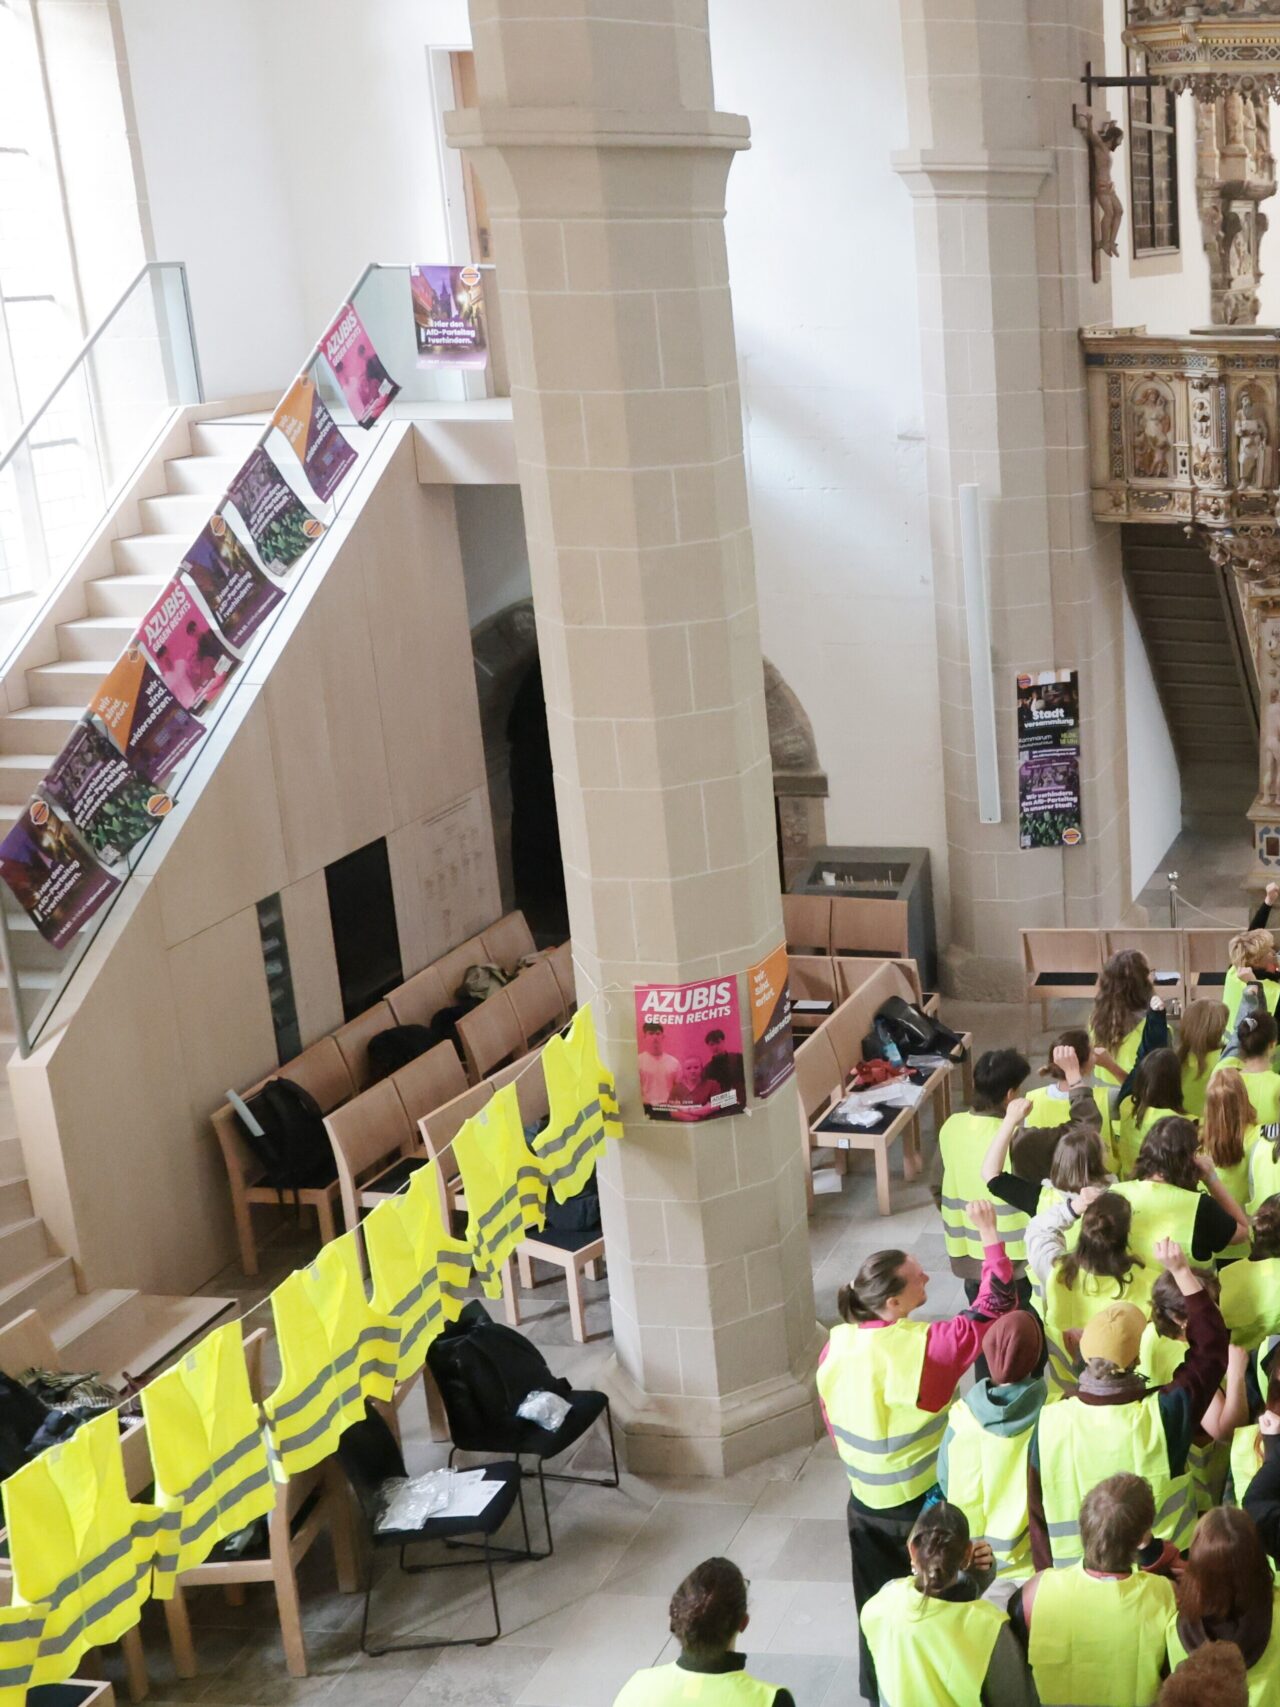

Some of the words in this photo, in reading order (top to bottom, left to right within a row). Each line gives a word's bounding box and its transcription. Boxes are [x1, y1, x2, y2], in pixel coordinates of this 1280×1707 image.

[326, 310, 358, 361] AZUBIS
[450, 320, 464, 328] den
[144, 584, 186, 648] AZUBIS
[152, 625, 172, 653] GEGEN
[145, 679, 161, 695] wir.
[148, 687, 168, 708] sind.
[129, 695, 174, 746] widersetzen.
[1024, 718, 1074, 728] versammlung
[1032, 708, 1064, 720] Stadt
[50, 864, 64, 880] den
[38, 860, 80, 911] AfD-Parteitag
[46, 872, 82, 913] verhindern.
[641, 982, 731, 1013] AZUBIS
[644, 1013, 684, 1025] GEGEN
[686, 1006, 731, 1024] RECHTS
